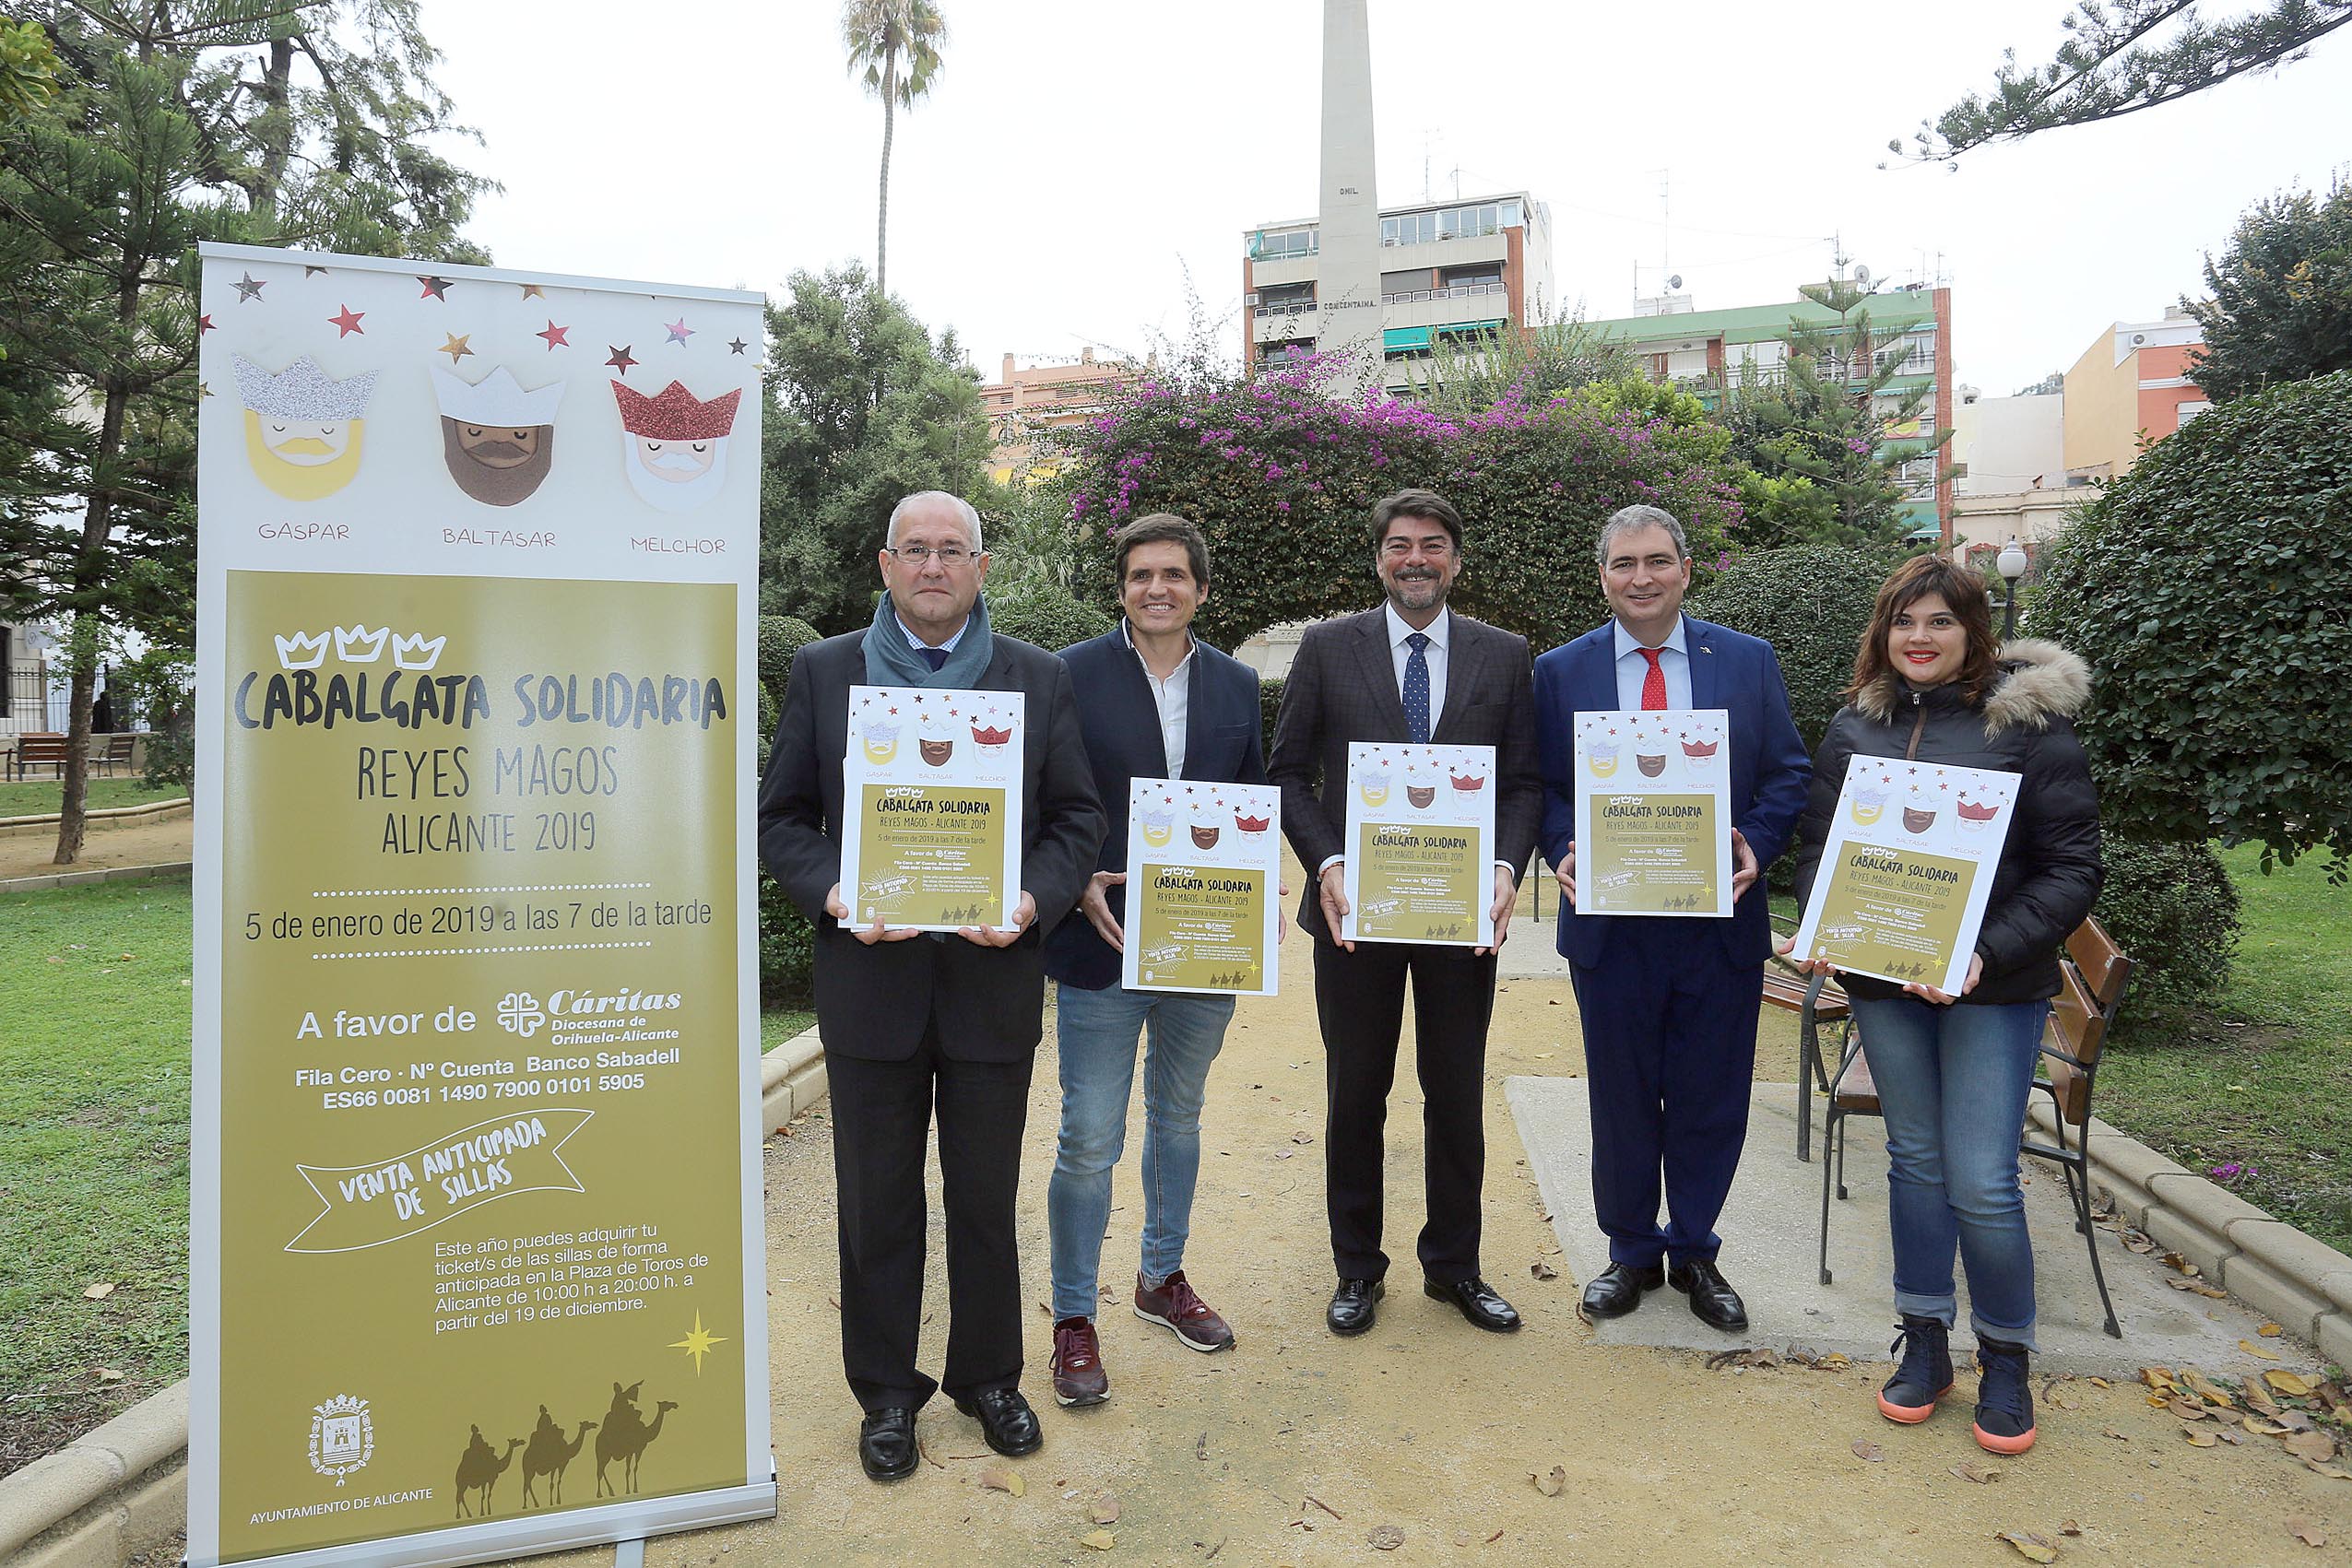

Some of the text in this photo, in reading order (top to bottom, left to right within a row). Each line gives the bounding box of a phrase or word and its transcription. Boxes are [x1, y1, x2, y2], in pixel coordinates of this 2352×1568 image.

[258, 523, 726, 554] GASPAR BALTASAR MELCHOR
[234, 669, 727, 729] CABALGATA SOLIDARIA
[358, 744, 618, 800] REYES MAGOS
[877, 798, 990, 815] CABALGATA SOLIDARIA
[879, 816, 986, 830] REYES MAGOS ALICANTE 2019
[1603, 806, 1702, 818] CABALGATA SOLIDARIA
[383, 811, 596, 854] ALICANTE 2019
[1372, 834, 1467, 849] CABALGATA SOLIDARIA
[1606, 821, 1699, 830] REYES MAGOS ALICANTE 2019
[1374, 849, 1463, 861] REYES MAGOS ALICANTE 2019
[1850, 855, 1959, 885] CABALGATA SOLIDARIA
[1154, 876, 1252, 893] CABALGATA SOLIDARIA
[1156, 892, 1248, 905] REYES MAGOS ALICANTE 2019
[1850, 870, 1951, 897] REYES MAGOS ALICANTE 2019
[245, 898, 712, 940] 5 de enero de 2019 a las 7 de la tarde
[296, 987, 682, 1040] A favor de Cáritas
[550, 1015, 646, 1032] Diocesana de
[550, 1029, 680, 1046] Orihuela-Alicante
[295, 1047, 680, 1087] Fila Cero Nº Cuenta Banco Sabadell
[324, 1073, 644, 1110] ES66 0081 1490 7900 0101 5905
[338, 1117, 547, 1203] VENTA ANTICIPADA
[394, 1158, 513, 1220] DE SILLAS
[435, 1224, 657, 1257] Este año puedes adquirir tu
[434, 1254, 709, 1294] anticipada en la Plaza de Toros de
[435, 1242, 668, 1276] ticket/s de las sillas de forma
[434, 1274, 694, 1314] Alicante de 10:00 h a 20:00 h. a
[435, 1297, 647, 1335] partir del 19 de diciembre.
[250, 1488, 432, 1525] AYUNTAMIENTO DE ALICANTE
